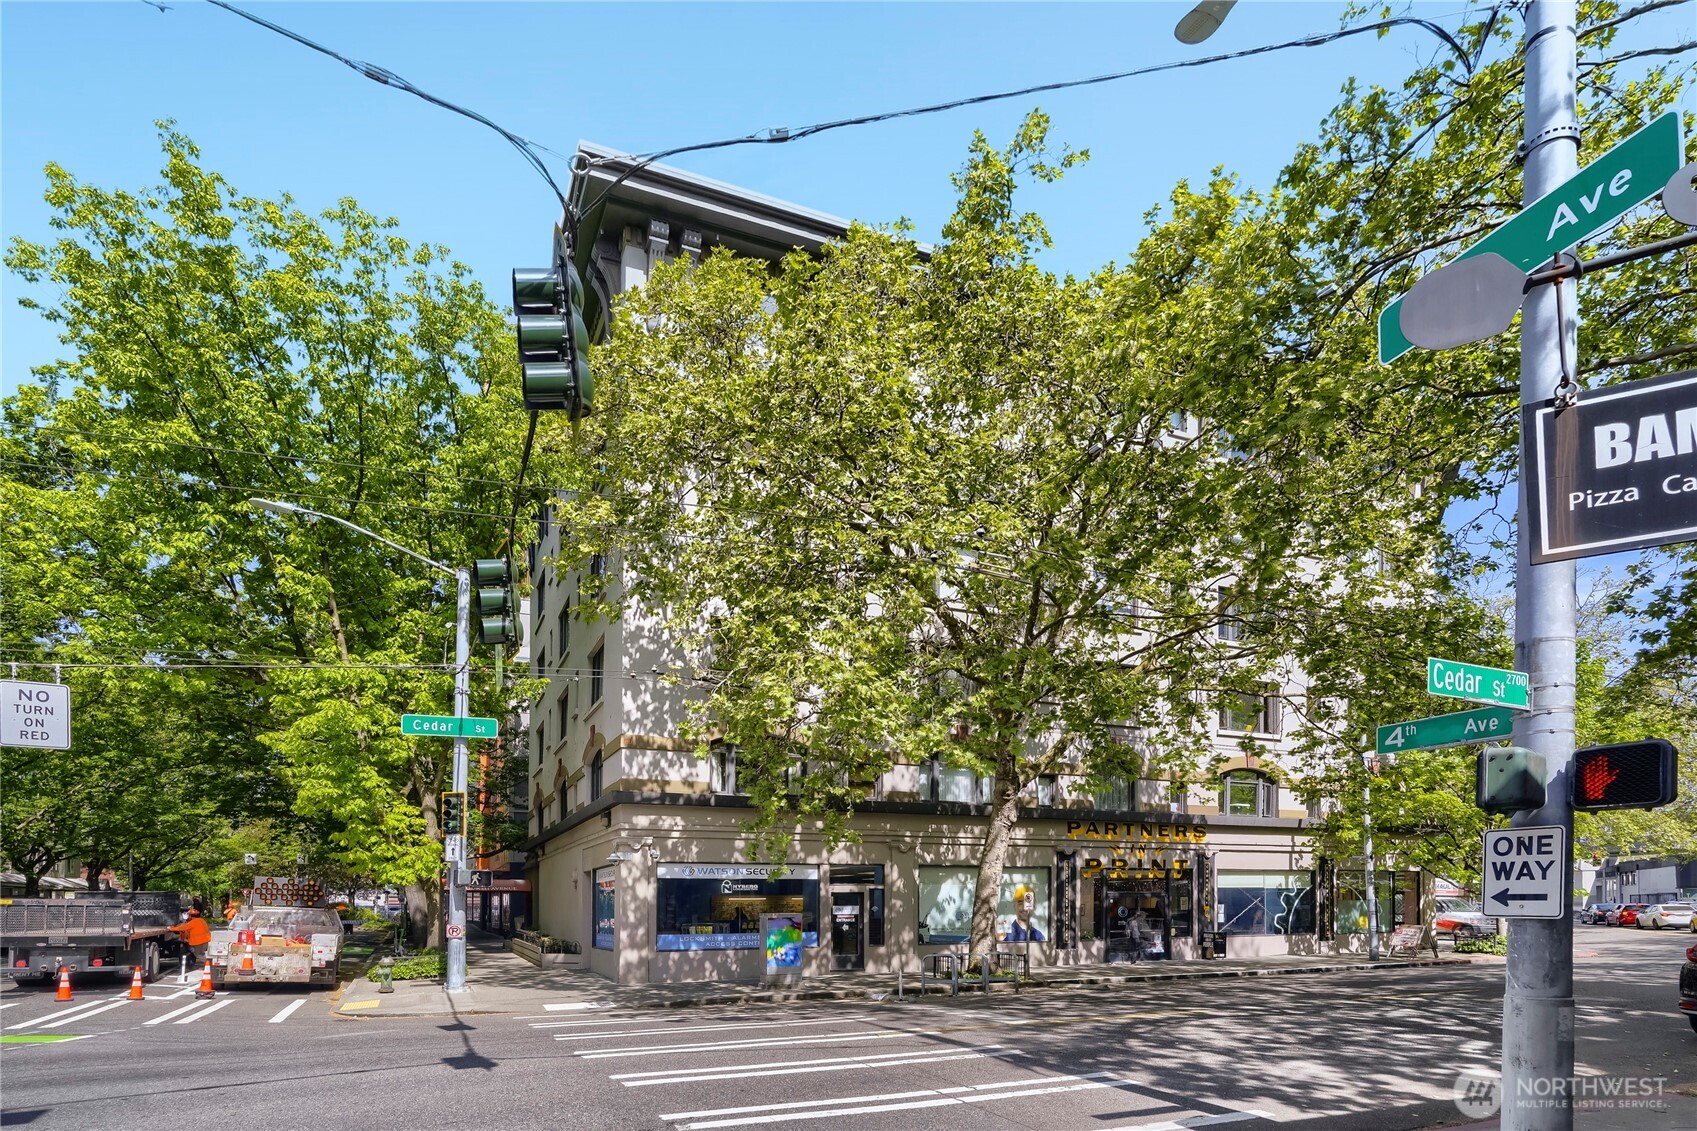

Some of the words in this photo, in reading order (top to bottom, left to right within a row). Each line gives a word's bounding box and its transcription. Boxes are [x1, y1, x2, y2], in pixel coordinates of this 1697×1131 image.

[1546, 168, 1632, 242] Ave
[1569, 485, 1639, 511] Pizza
[1433, 662, 1483, 694] Cedar
[1492, 679, 1506, 698] St
[1506, 673, 1526, 687] 2700
[18, 689, 50, 702] NO
[13, 703, 54, 716] TURN
[24, 717, 45, 728] ON
[412, 719, 454, 732] Cedar
[475, 724, 486, 733] St
[20, 730, 50, 741] RED
[1384, 724, 1417, 748] 4th
[1464, 717, 1499, 735] Ave
[1067, 821, 1207, 839] PARTNERS
[1130, 844, 1147, 854] IN
[1492, 834, 1554, 856] ONE
[697, 867, 743, 876] WATSON
[745, 868, 796, 876] SECUY
[1082, 858, 1188, 878] PRINT
[1492, 860, 1556, 881] WAY
